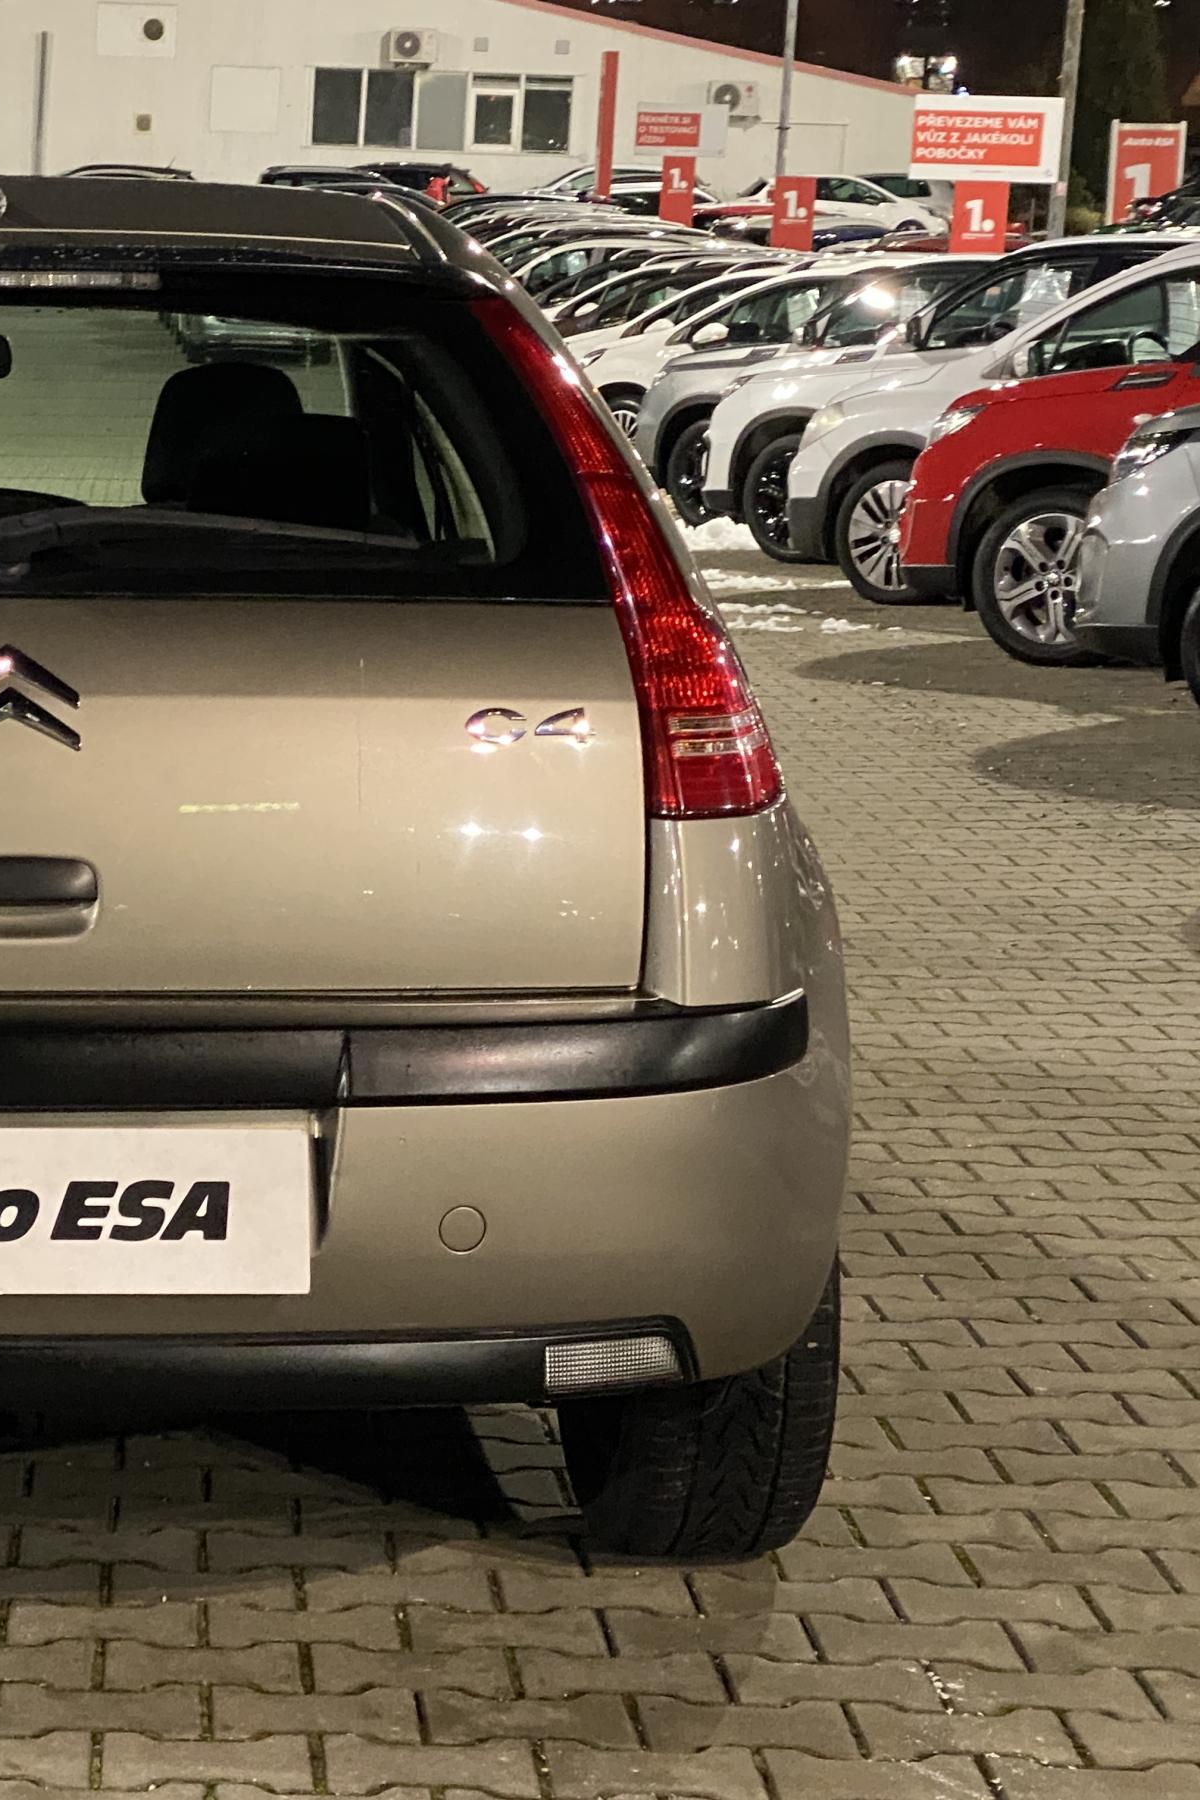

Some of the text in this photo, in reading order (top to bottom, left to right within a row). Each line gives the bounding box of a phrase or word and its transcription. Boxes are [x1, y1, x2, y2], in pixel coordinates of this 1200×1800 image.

[916, 115, 1038, 129] PŘEVEZEME VÁM
[916, 129, 1033, 145] VŮZ Z JAKÉKOLI
[915, 146, 987, 159] POBOČKY
[669, 168, 688, 189] 1.
[783, 190, 808, 218] 1.
[964, 199, 995, 232] 1.
[464, 707, 596, 744] C4
[50, 1180, 231, 1242] ESA
